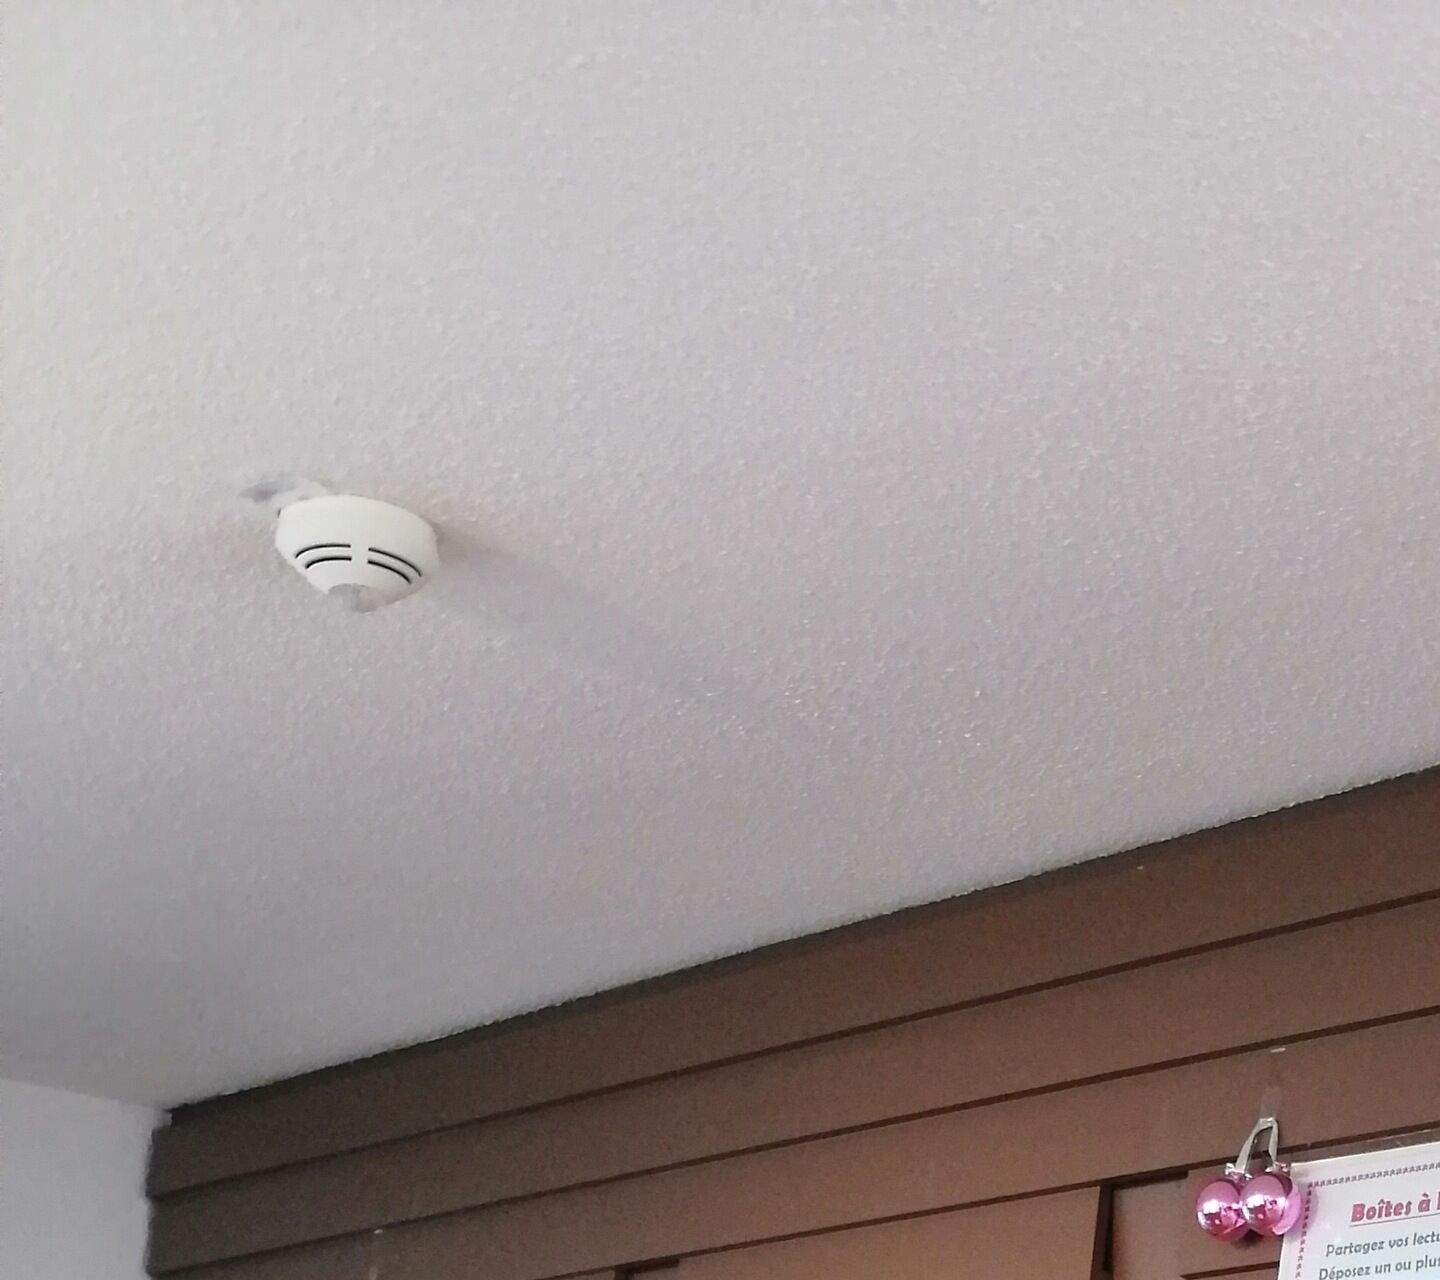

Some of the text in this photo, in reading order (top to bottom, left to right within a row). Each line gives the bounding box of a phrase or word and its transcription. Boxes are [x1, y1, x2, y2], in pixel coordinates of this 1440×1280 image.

[1351, 1198, 1413, 1223] Boîtes
[1418, 1190, 1431, 1214] à
[1326, 1238, 1384, 1258] Partagez
[1388, 1237, 1409, 1249] vos
[1375, 1262, 1391, 1274] un
[1395, 1259, 1412, 1272] ou
